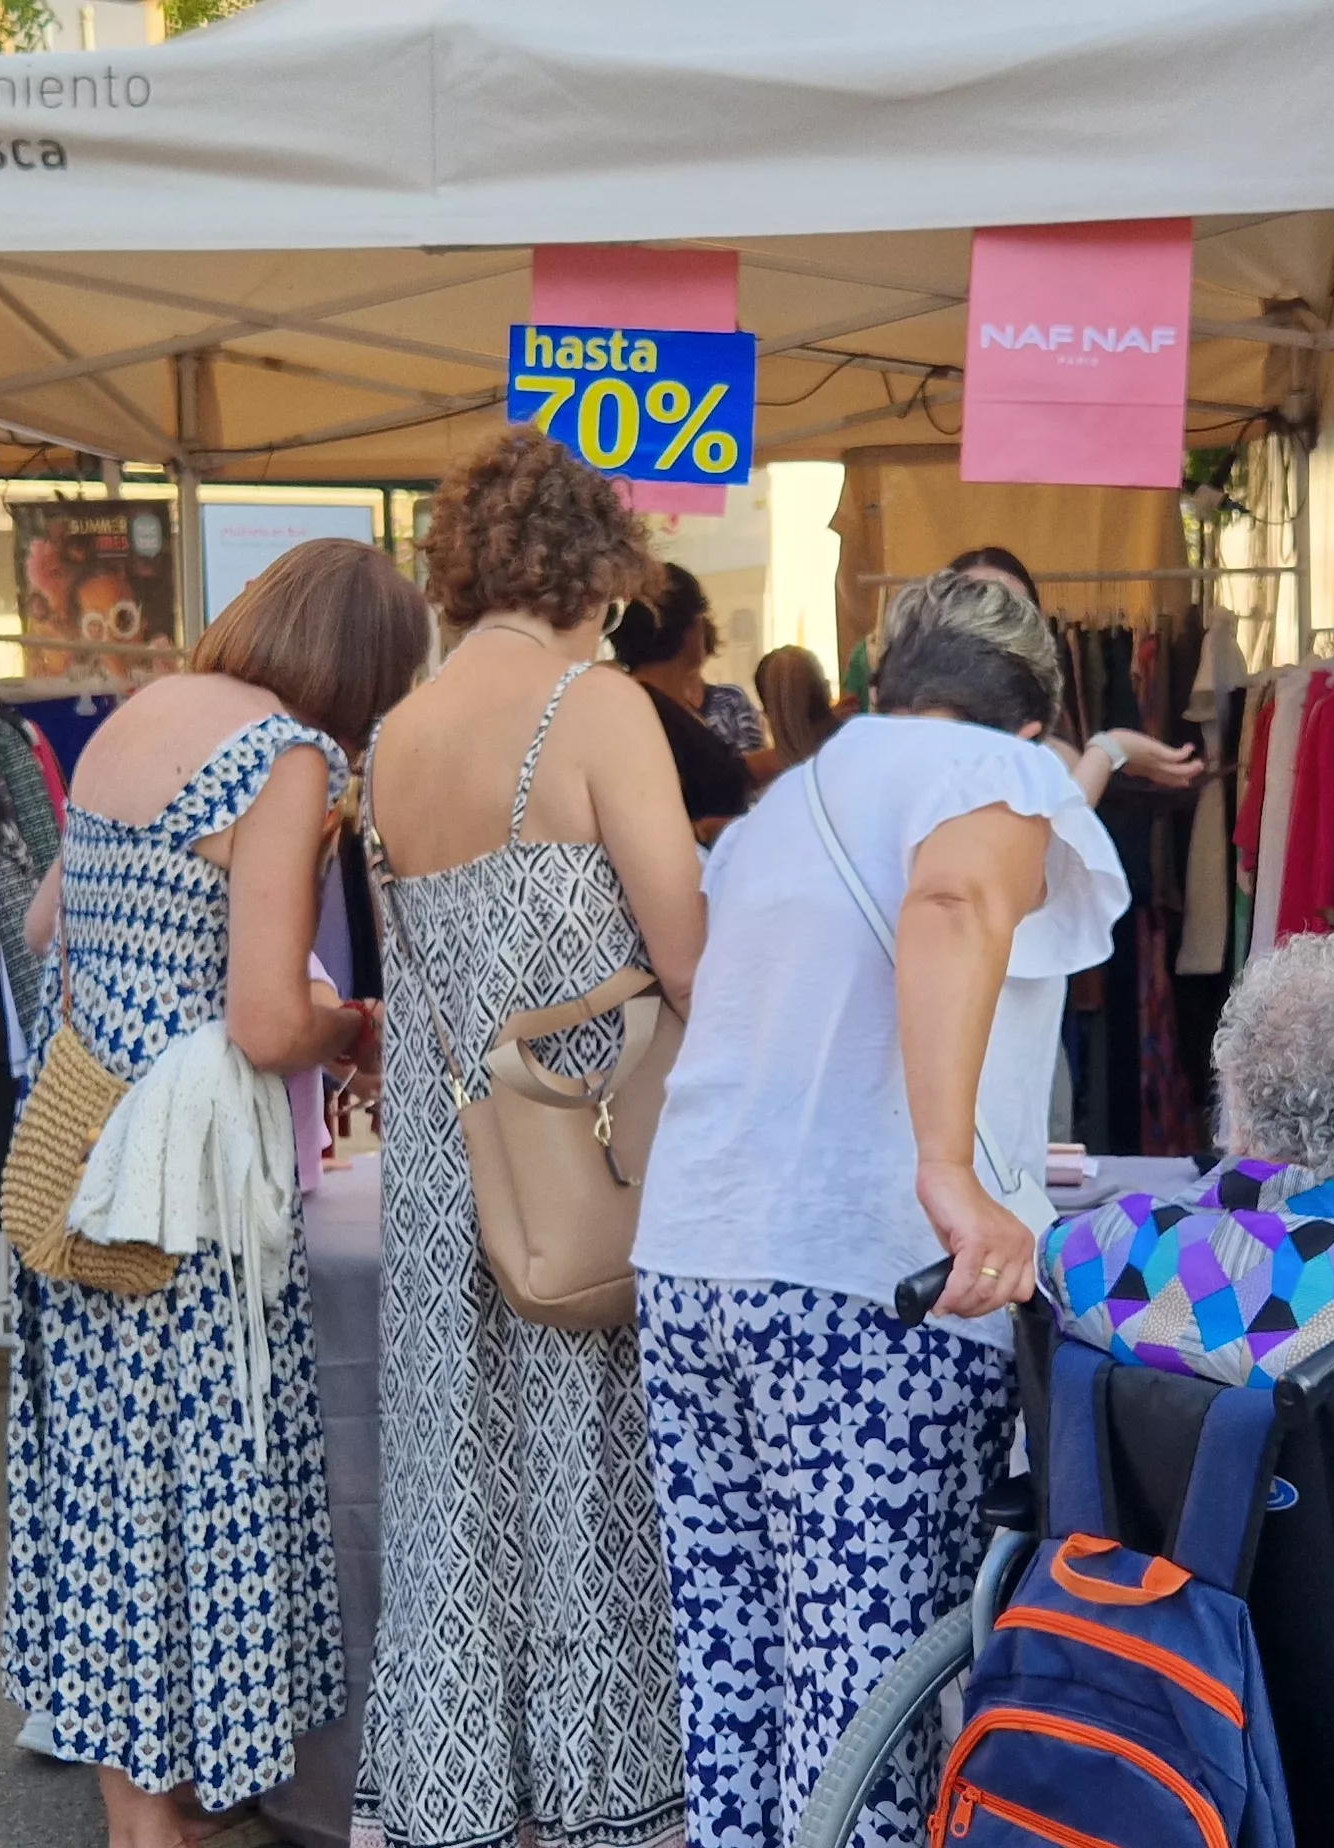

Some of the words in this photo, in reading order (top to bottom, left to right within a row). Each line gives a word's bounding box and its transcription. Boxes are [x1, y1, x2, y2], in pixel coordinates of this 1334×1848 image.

[524, 327, 658, 373] hasta
[980, 323, 1074, 351] NAF
[1083, 325, 1177, 353] NAF
[514, 375, 738, 474] 70%
